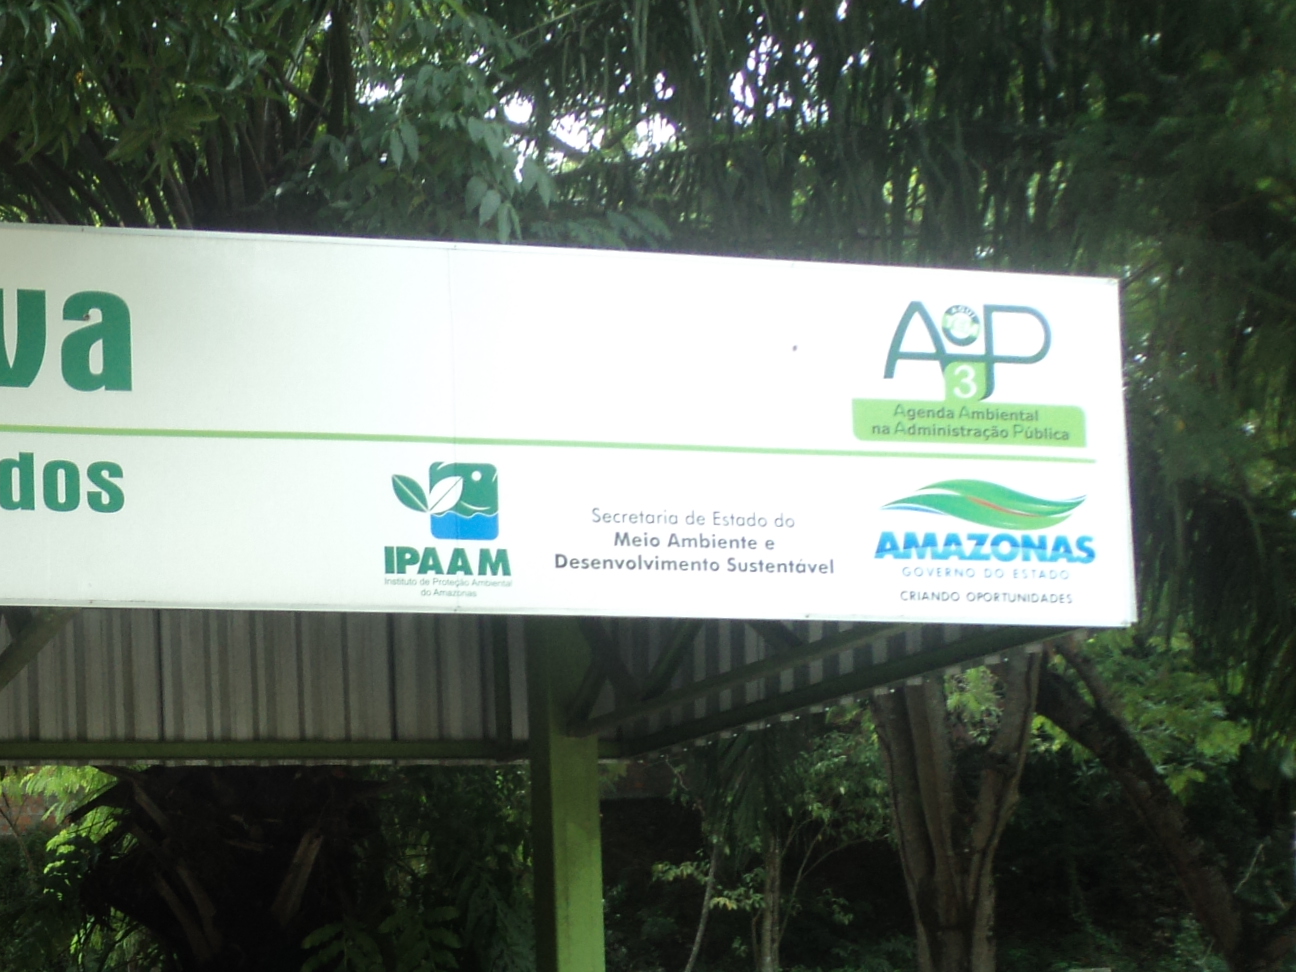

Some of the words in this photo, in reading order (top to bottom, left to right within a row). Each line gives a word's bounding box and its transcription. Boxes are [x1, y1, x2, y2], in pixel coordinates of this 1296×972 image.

[893, 403, 954, 421] Agenda
[958, 405, 1039, 422] Ambiental
[872, 425, 890, 435] na
[894, 422, 1009, 441] Administração
[1013, 424, 1070, 441] Pública
[591, 507, 679, 526] Secretaria
[685, 509, 706, 526] de
[713, 510, 767, 528] Estado
[774, 512, 795, 528] do
[614, 531, 661, 548] Meio
[667, 532, 758, 550] Ambiente
[765, 538, 775, 550] e
[874, 531, 1096, 564] AMAZONAS
[384, 545, 512, 577] IPAAM
[554, 553, 720, 572] Desenvolvimento
[726, 556, 835, 574] Sustentável
[384, 578, 418, 587] Instituto
[419, 578, 430, 586] de
[432, 577, 470, 588] Proteção
[471, 578, 513, 588] Ambiental
[901, 566, 976, 578] GOVERNO
[984, 567, 1005, 579] DO
[1013, 568, 1071, 581] ESTADO
[420, 588, 432, 597] do
[432, 588, 478, 597] Amazonas
[900, 590, 961, 602] CRIANDO
[966, 591, 1073, 604] OPORTUNIDADES
